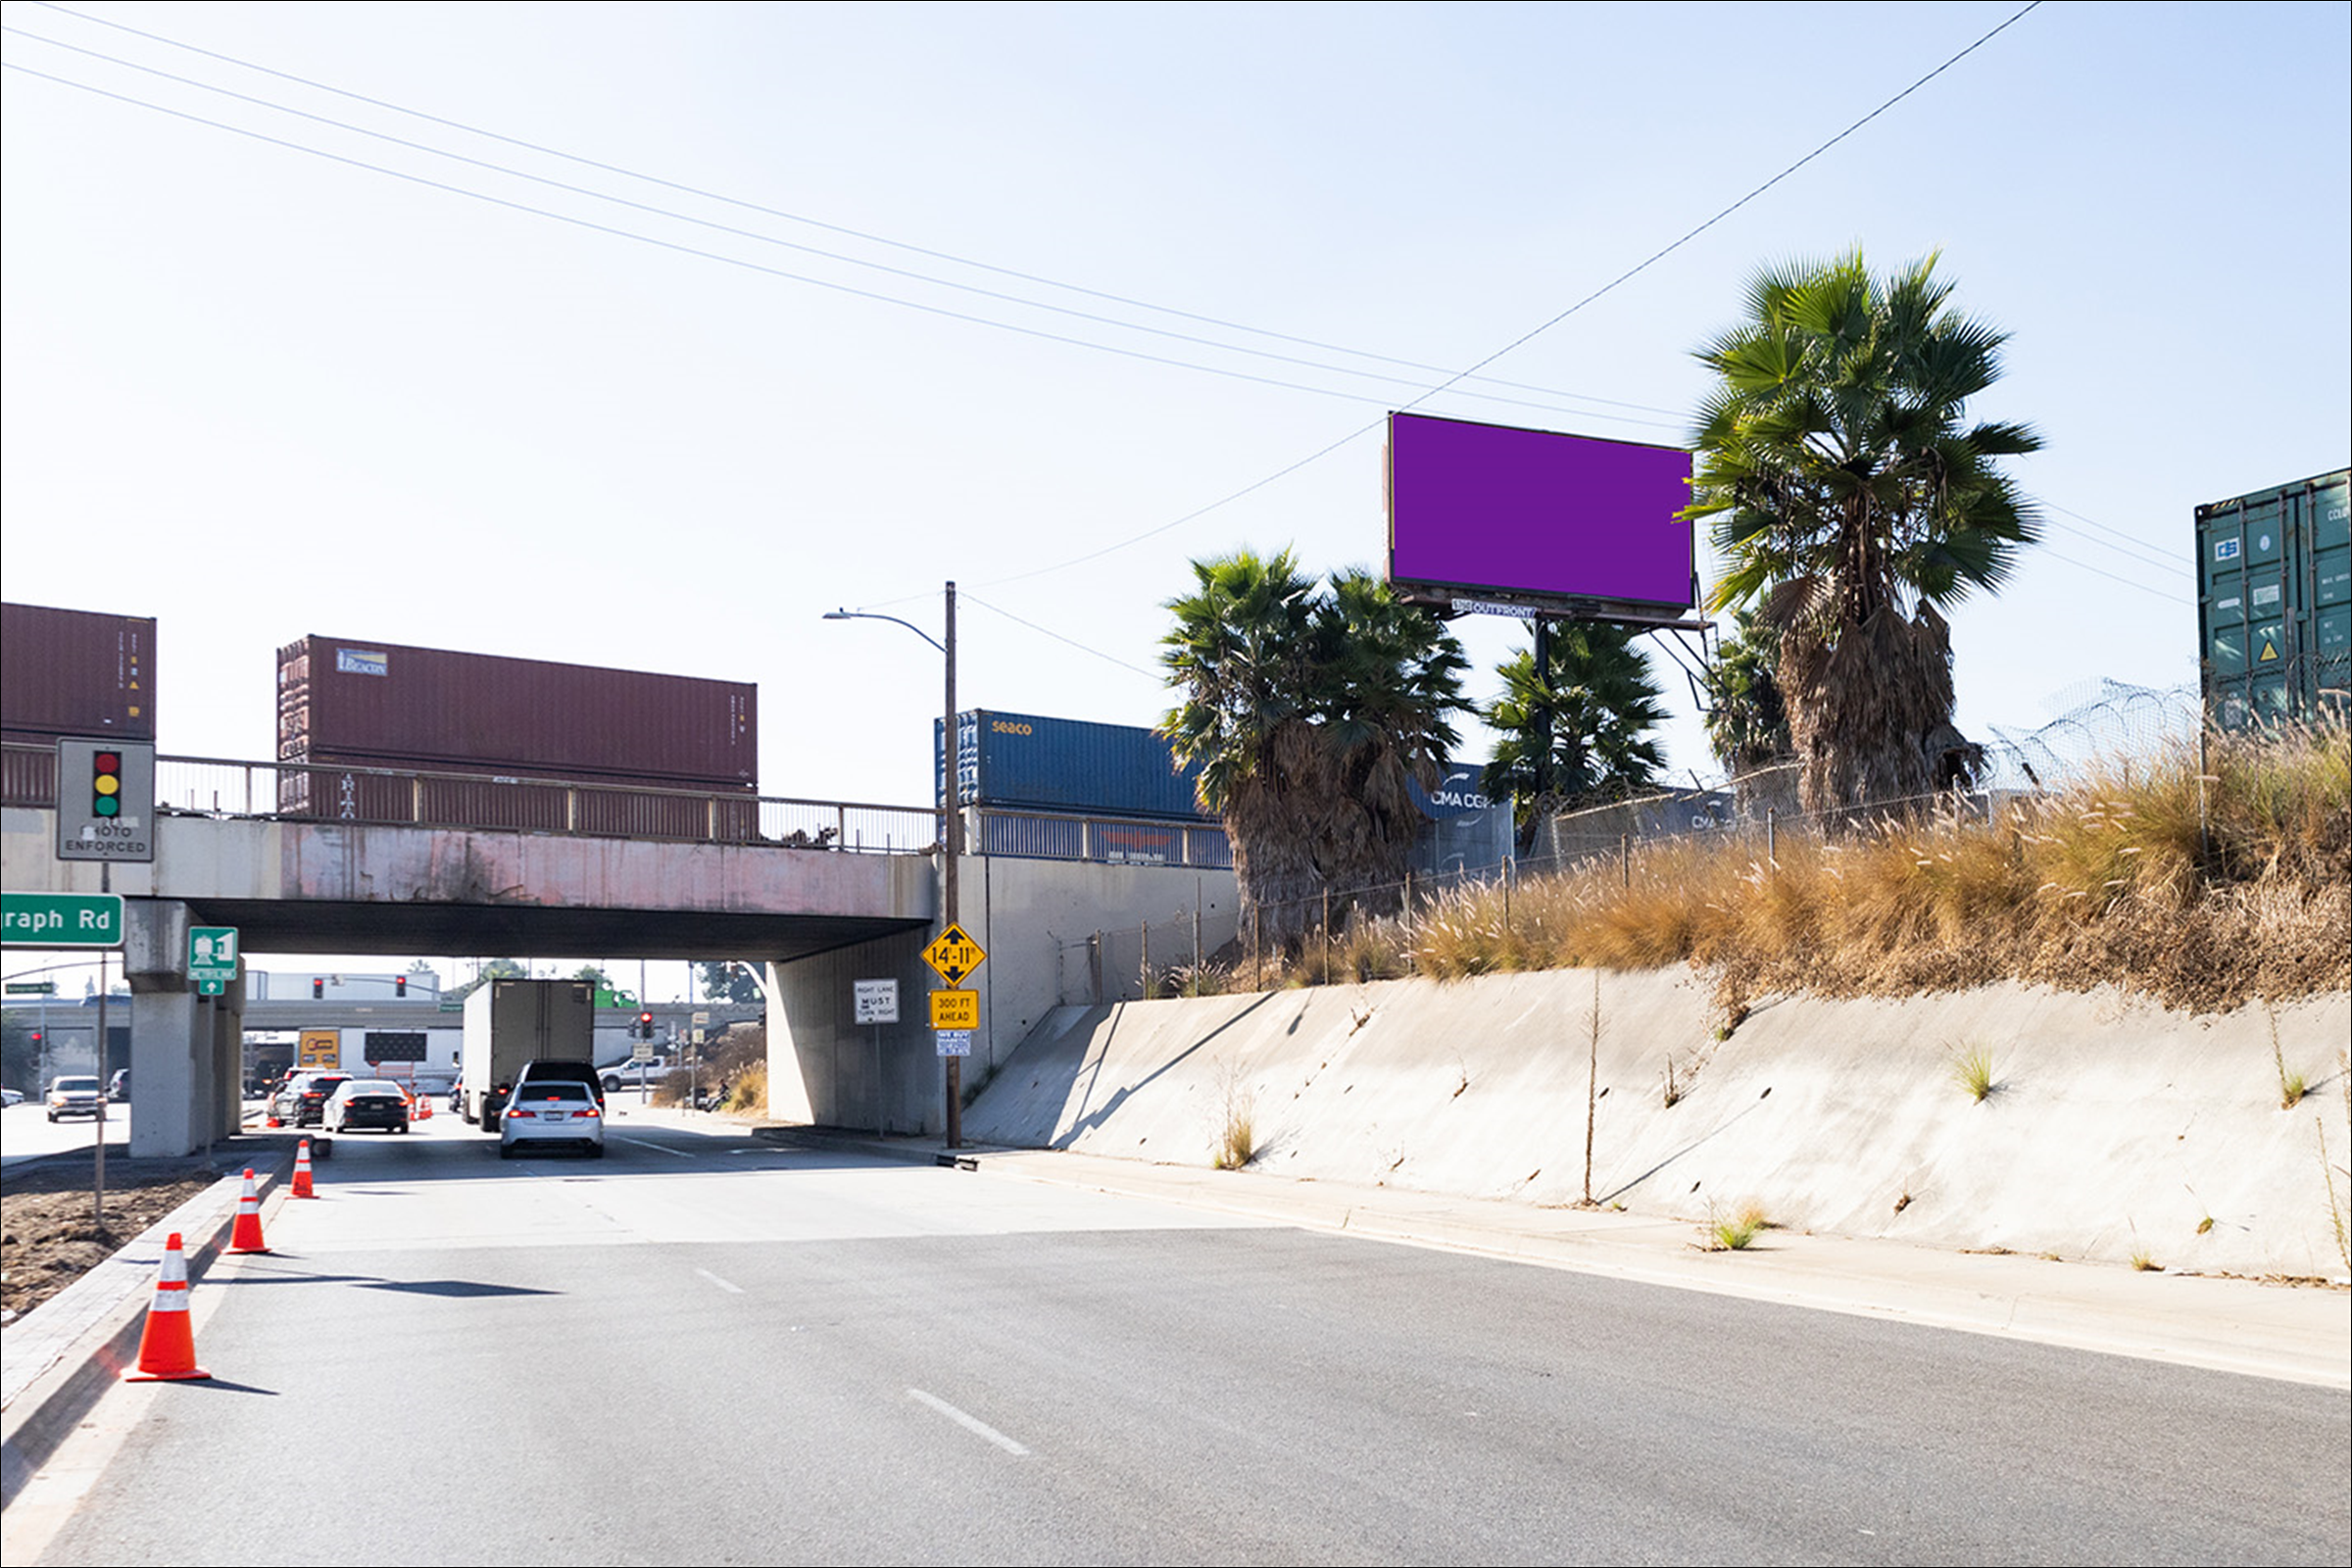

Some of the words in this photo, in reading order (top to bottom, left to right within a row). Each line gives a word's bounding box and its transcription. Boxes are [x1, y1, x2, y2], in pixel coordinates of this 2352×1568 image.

[992, 720, 1032, 735] seaco
[1431, 791, 1462, 807] CMA
[66, 840, 145, 853] ENFORCED
[1, 909, 63, 933] raph
[79, 909, 110, 929] Rd
[939, 998, 956, 1008] 300
[959, 998, 970, 1007] FT
[939, 1011, 970, 1022] AHEAD
